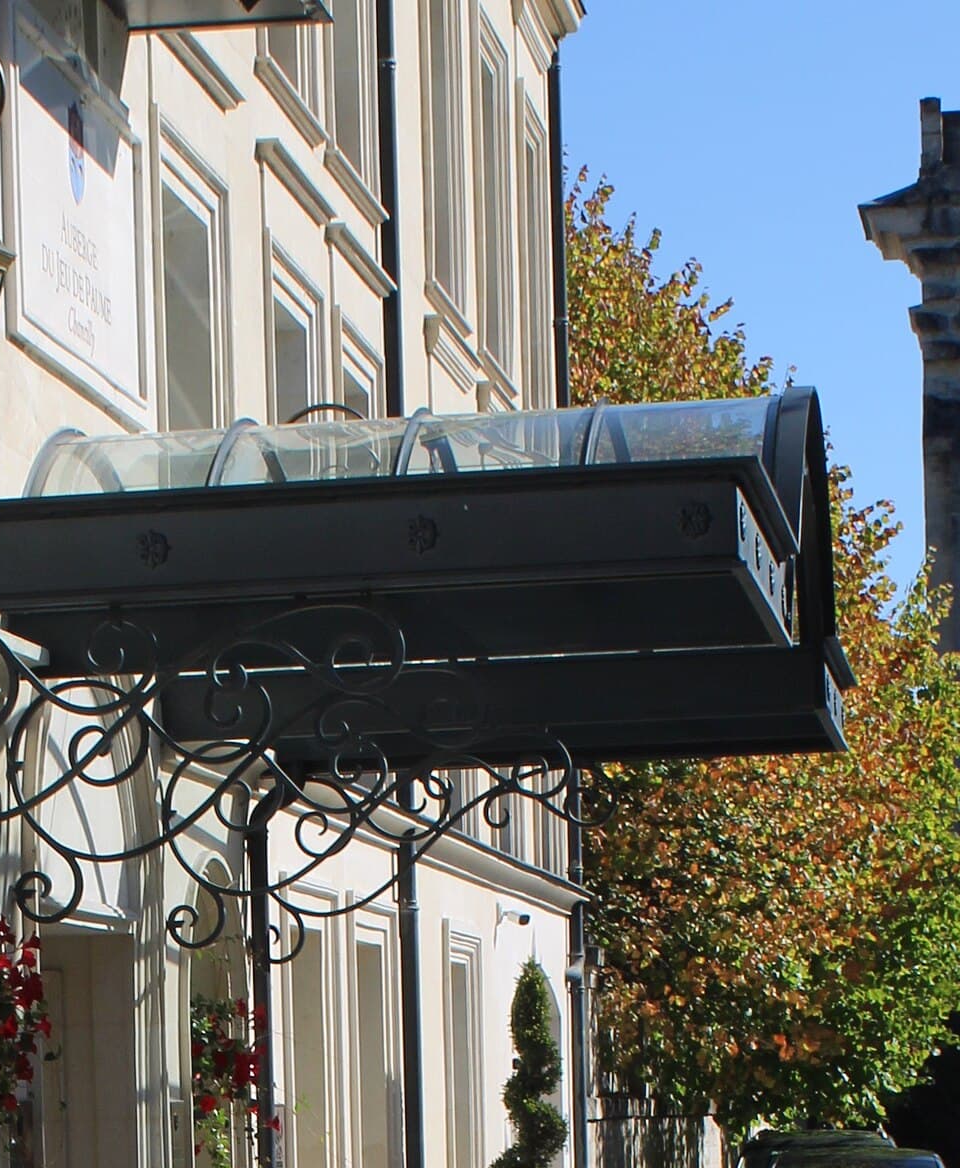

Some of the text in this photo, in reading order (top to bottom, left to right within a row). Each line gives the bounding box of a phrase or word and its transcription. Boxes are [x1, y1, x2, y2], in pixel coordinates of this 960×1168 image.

[60, 211, 98, 271] AUBERGE
[41, 243, 112, 326] DU JEU DE PAUME
